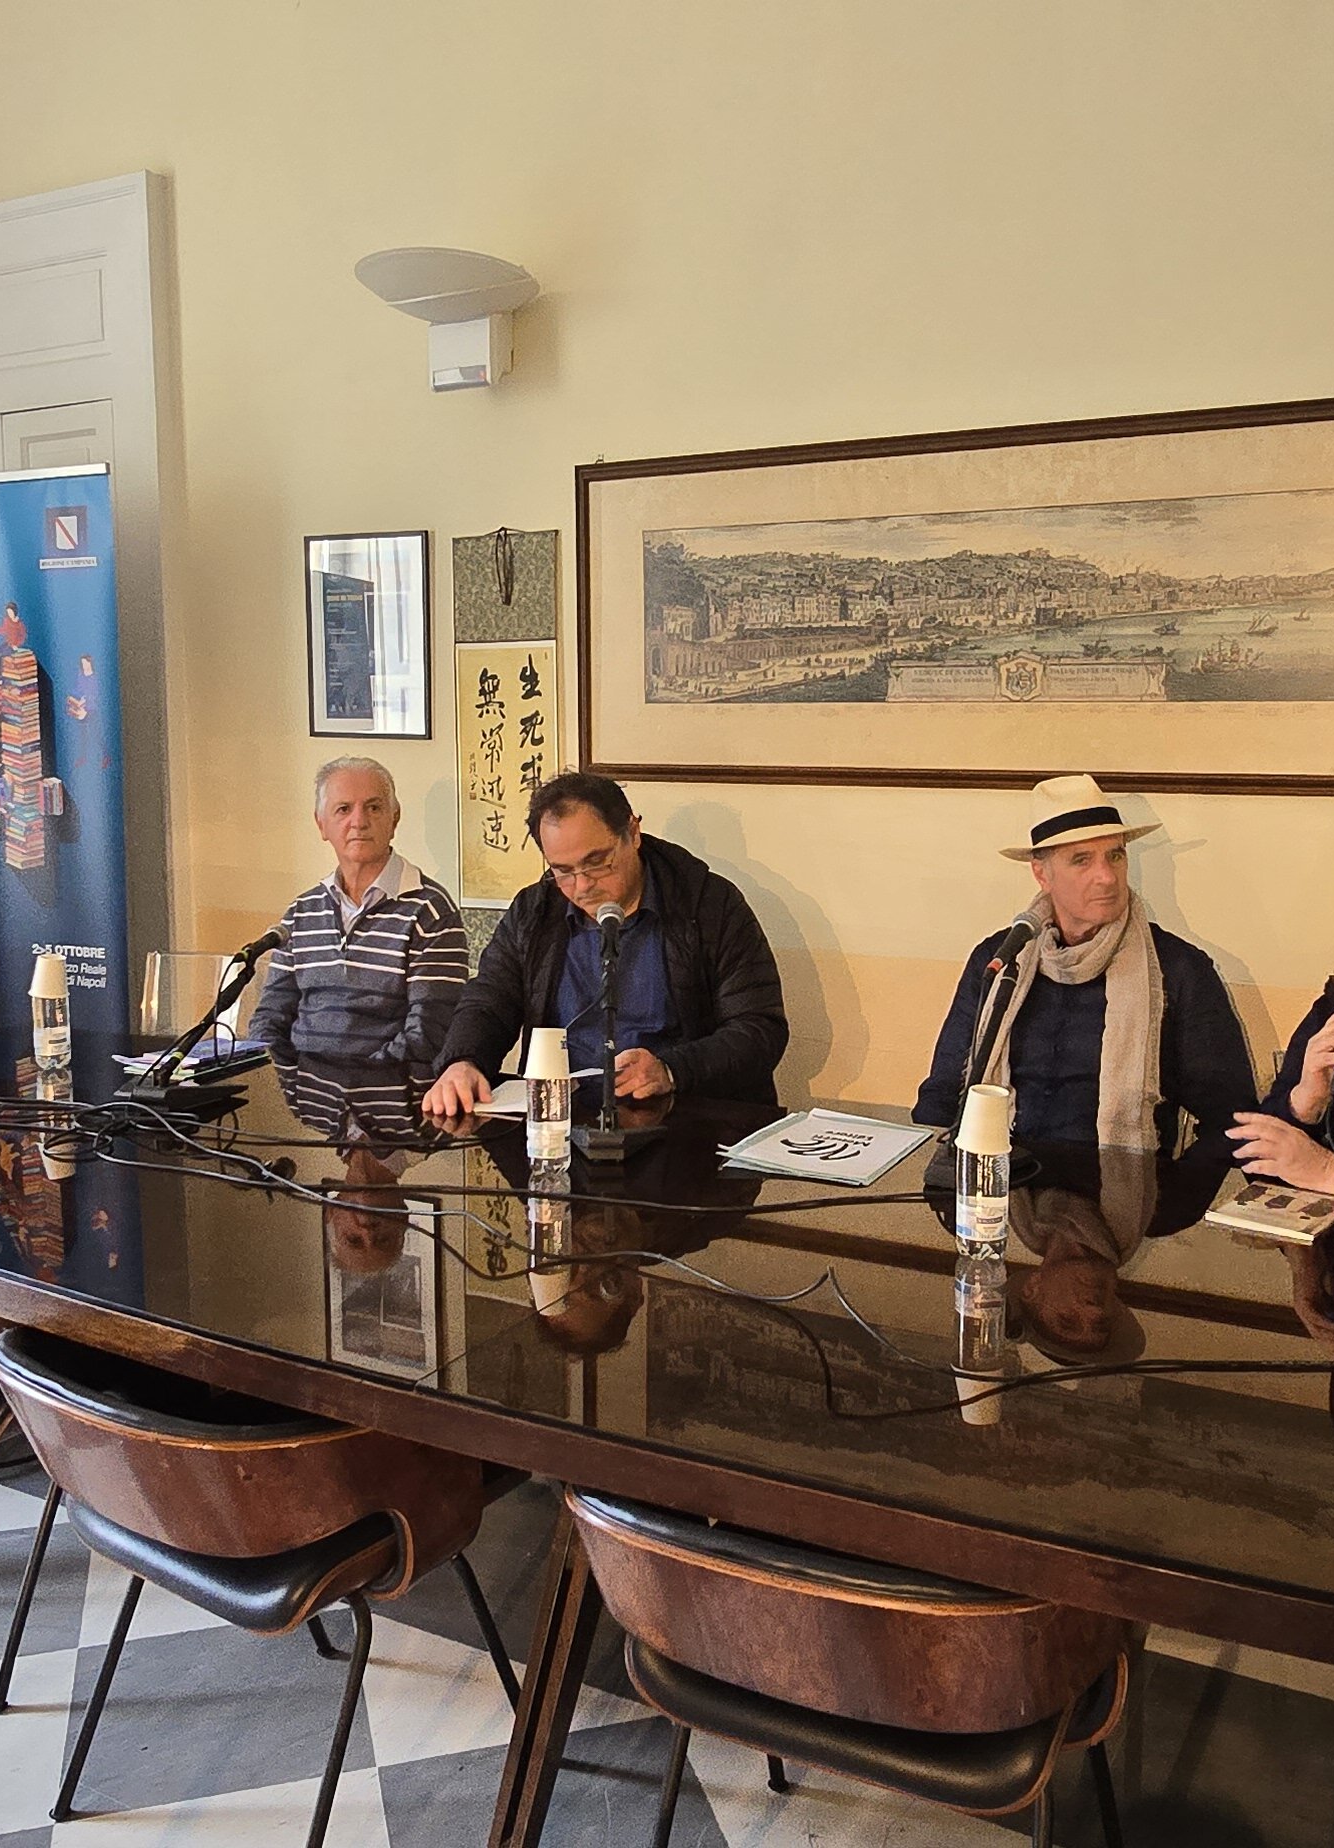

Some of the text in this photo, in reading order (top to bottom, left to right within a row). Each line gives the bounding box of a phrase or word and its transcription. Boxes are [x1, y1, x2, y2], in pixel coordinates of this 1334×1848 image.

[54, 945, 106, 959] OTTOBRE
[80, 962, 107, 976] Reale
[67, 975, 107, 989] di Napoli
